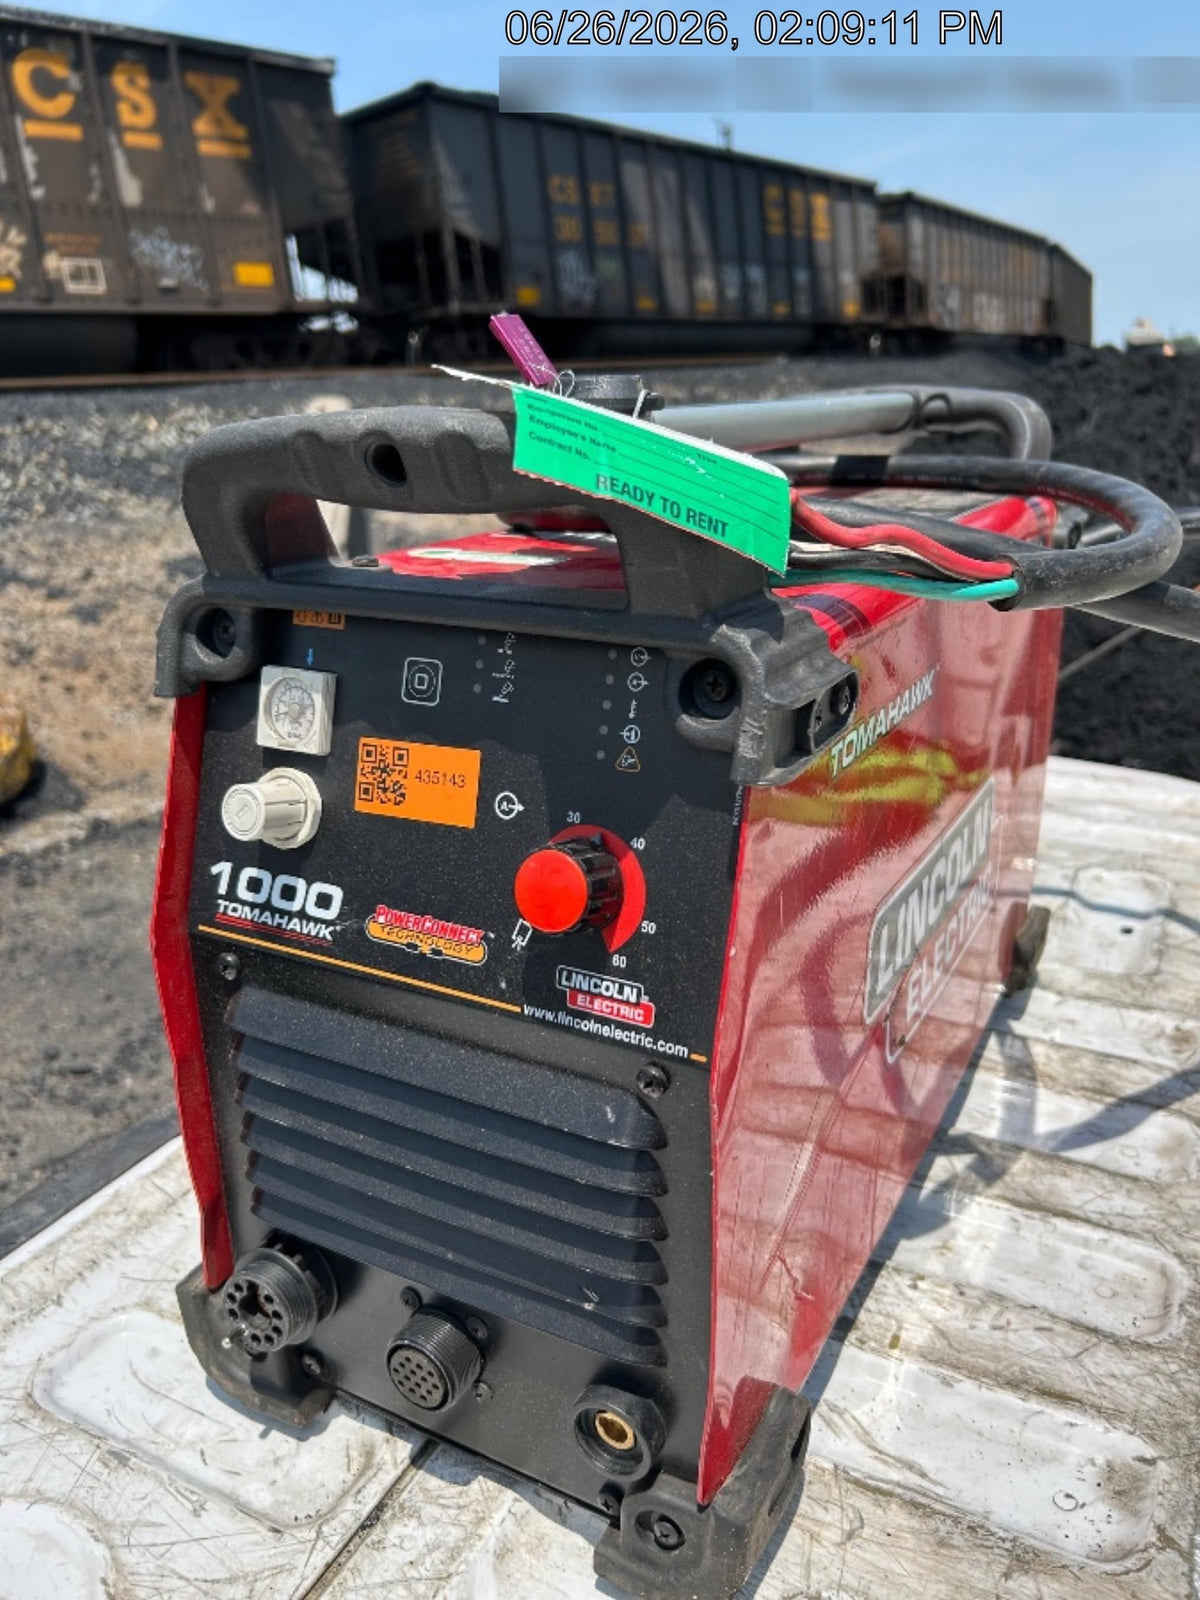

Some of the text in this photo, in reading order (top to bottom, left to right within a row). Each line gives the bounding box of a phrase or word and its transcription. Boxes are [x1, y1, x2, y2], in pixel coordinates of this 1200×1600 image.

[11, 46, 249, 141] CSX
[528, 431, 573, 453] Contract
[596, 474, 729, 538] READY TO RENT
[831, 669, 935, 777] TOMAHAWK
[414, 769, 466, 788] 435143
[566, 811, 581, 824] 30
[630, 837, 646, 850] 40
[210, 861, 344, 920] 1000
[876, 799, 991, 995] LINCOLN
[216, 899, 336, 941] TOMAHAWK
[641, 920, 656, 935] 50
[380, 926, 474, 955] TECHNOLOGY
[906, 860, 994, 1022] ELECTRIC
[612, 954, 627, 968] 60
[561, 970, 639, 1003] LINCOLN
[577, 994, 645, 1021] ELECTRIC
[523, 1003, 689, 1058] www.lincolnelectric.com
